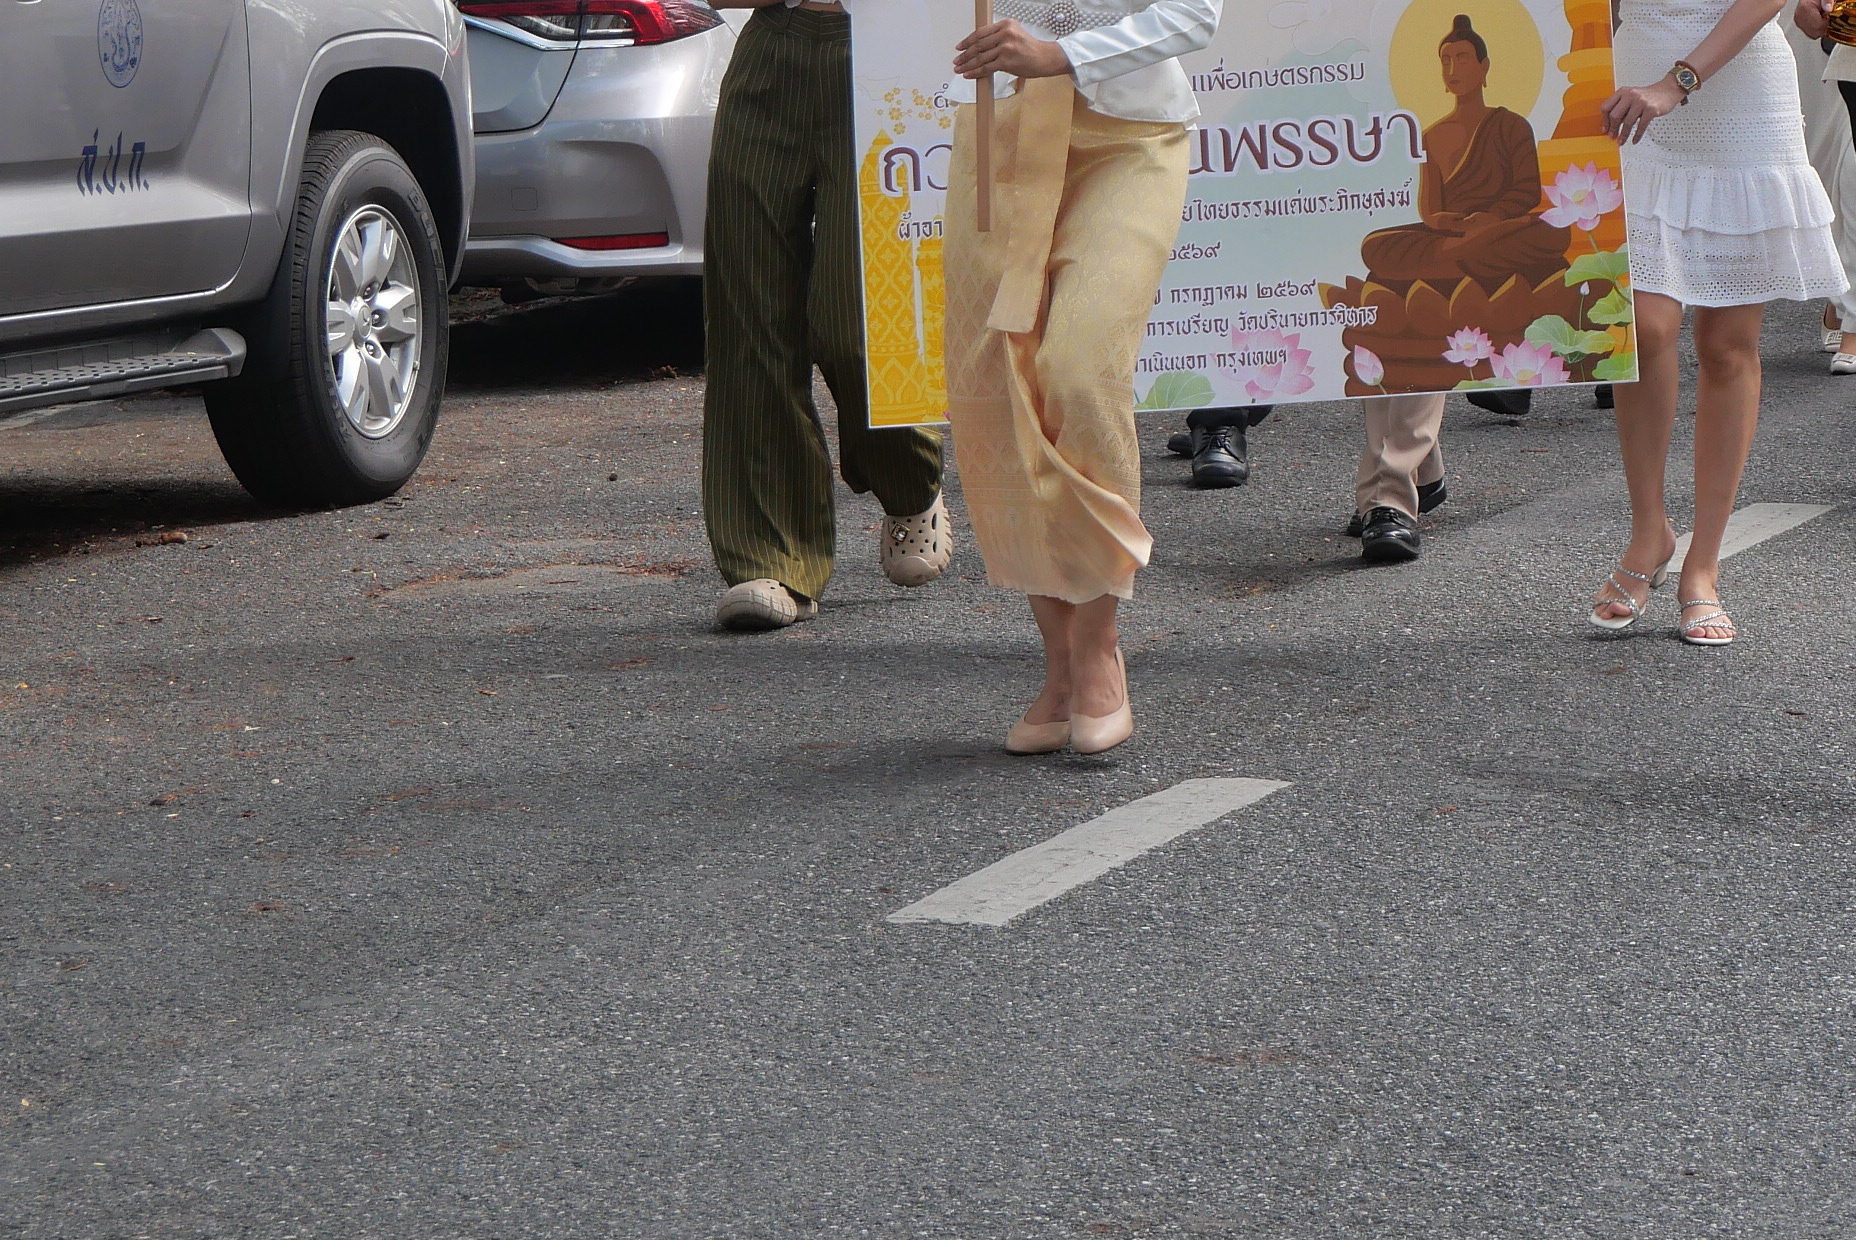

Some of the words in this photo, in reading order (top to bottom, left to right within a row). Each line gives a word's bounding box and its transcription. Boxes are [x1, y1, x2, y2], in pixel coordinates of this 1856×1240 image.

[1169, 284, 1248, 307] กรกฎาคม
[1256, 278, 1317, 299] ๒๕๖๙
[1216, 348, 1288, 374] กรุงเทพฯ
